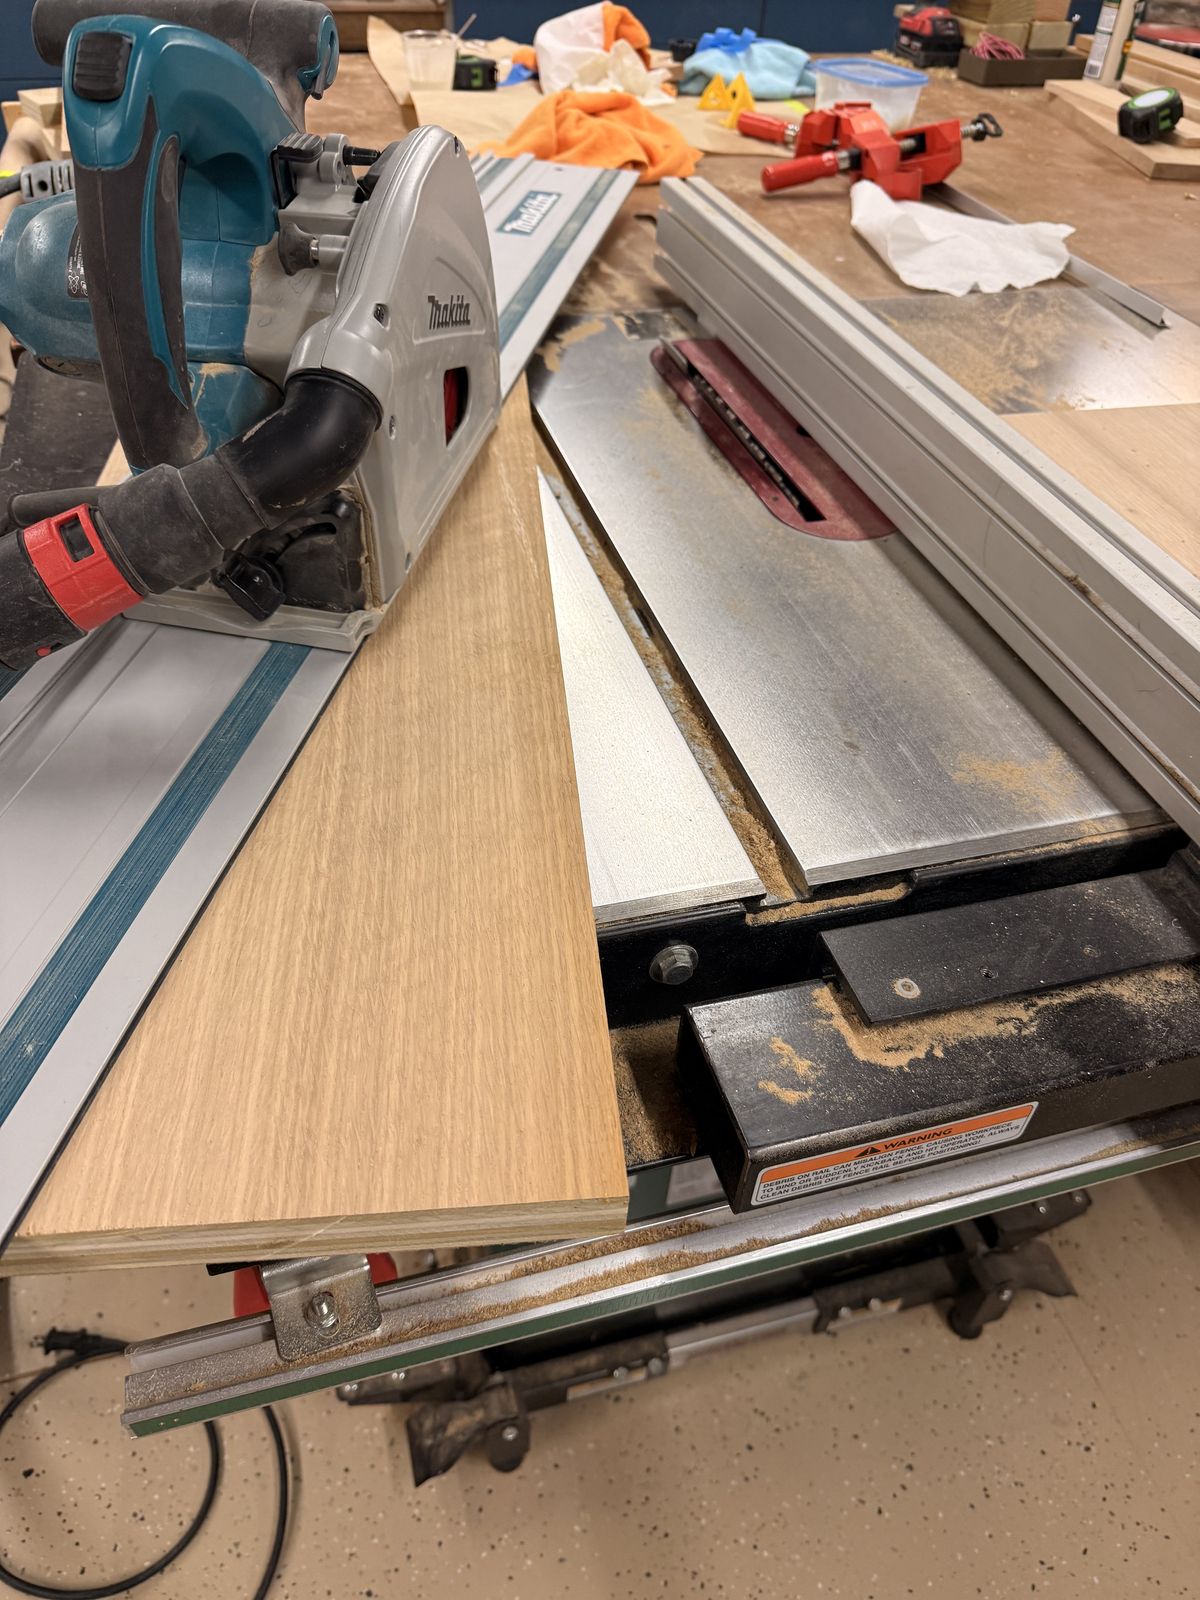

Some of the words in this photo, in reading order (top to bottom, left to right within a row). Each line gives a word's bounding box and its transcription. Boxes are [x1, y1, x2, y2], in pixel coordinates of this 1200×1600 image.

[428, 295, 471, 330] Makita
[760, 1189, 789, 1200] CLEAN
[791, 1181, 823, 1192] DEBRIS
[824, 1176, 842, 1184] OFF
[842, 1168, 871, 1179] FENCE
[871, 1163, 890, 1172] RAIL
[892, 1152, 926, 1166] BEFORE
[927, 1139, 981, 1157] POSITIONING!
[763, 1177, 795, 1188] DEBRIS
[811, 1169, 831, 1177] RAIL
[833, 1163, 851, 1171] CAN
[853, 1152, 893, 1166] MISALIGN
[926, 1135, 963, 1147] CAUSING
[964, 1121, 1013, 1137] WORKPIECE
[775, 1182, 797, 1191] BIND
[814, 1166, 860, 1181] SUDDENLY
[860, 1154, 905, 1169] KICKBACK
[905, 1149, 924, 1157] AND
[987, 1125, 1020, 1137] ALWAYS
[884, 1128, 953, 1150] WARNING
